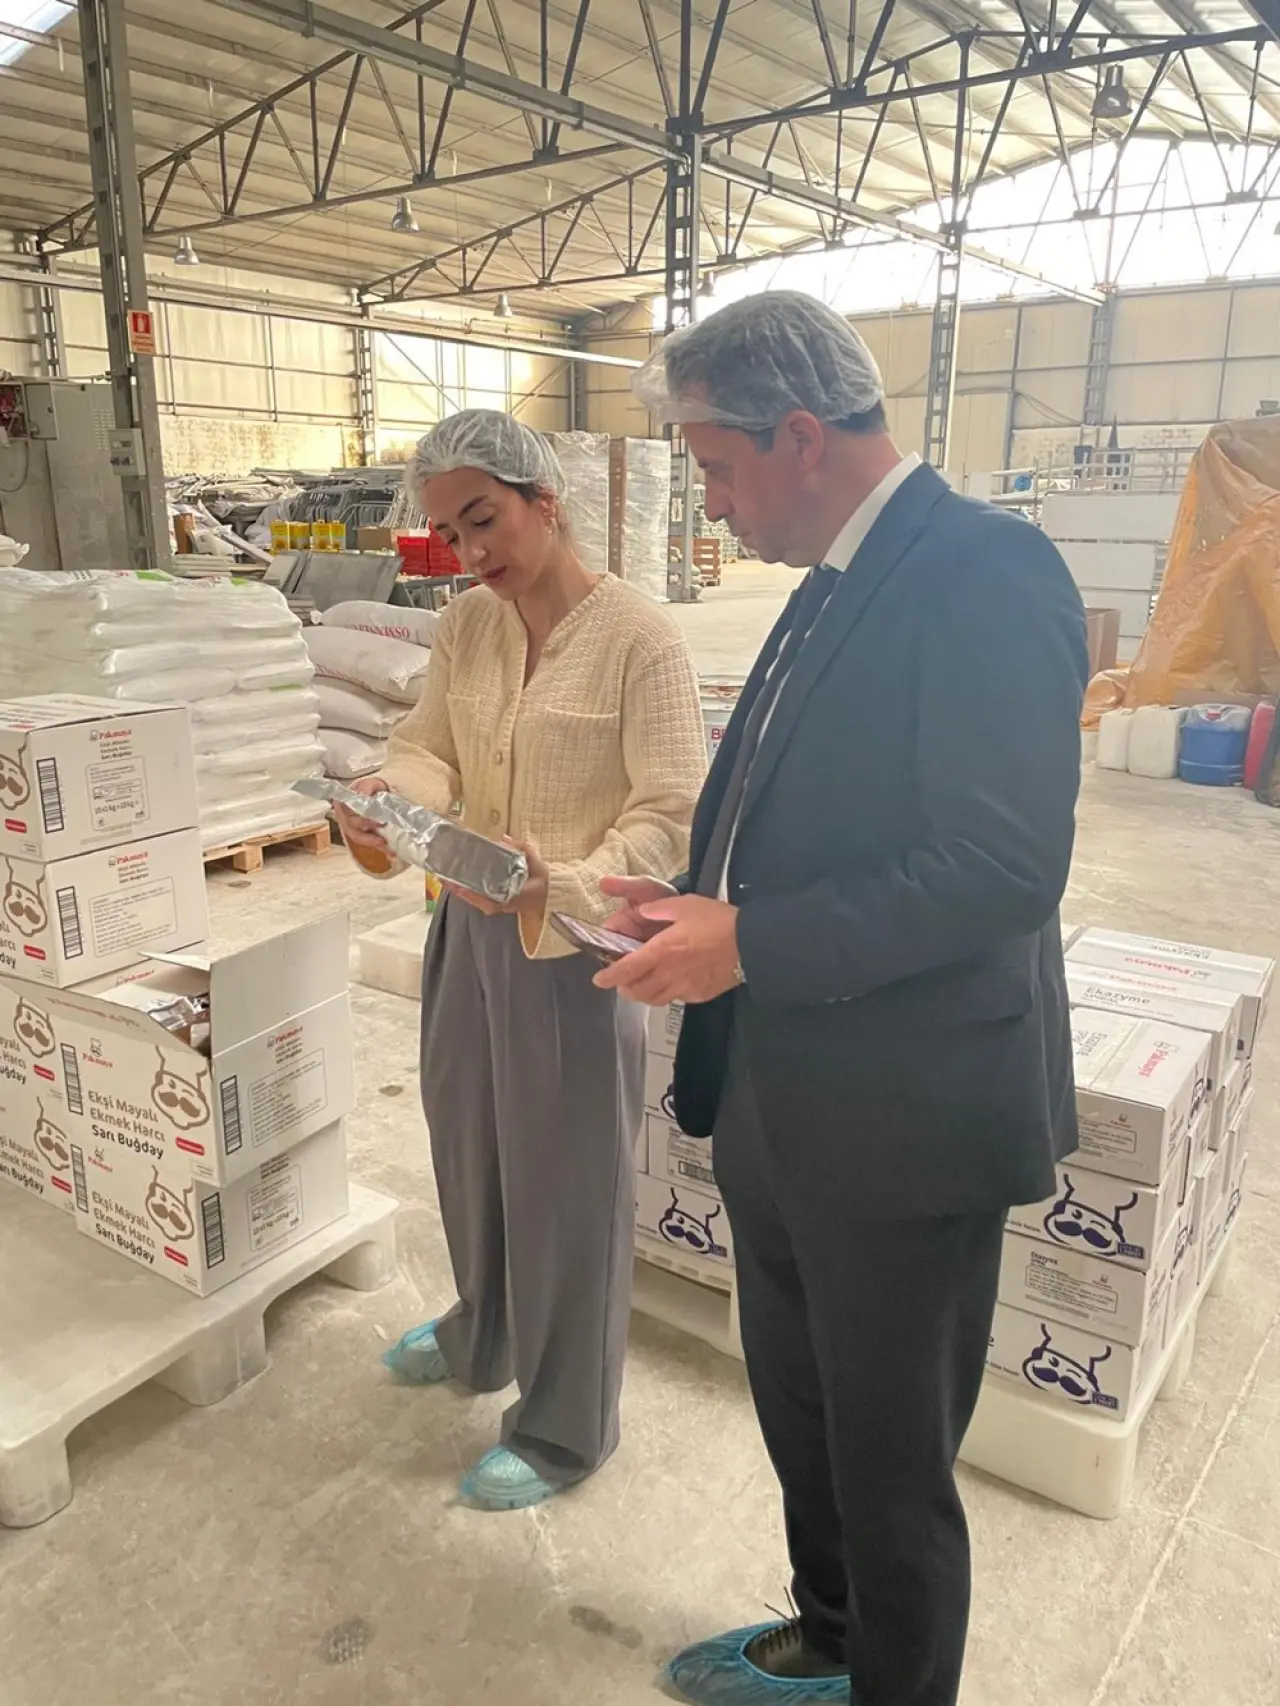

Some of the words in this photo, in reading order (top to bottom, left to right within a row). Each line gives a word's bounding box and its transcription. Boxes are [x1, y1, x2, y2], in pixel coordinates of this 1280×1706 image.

[88, 1090, 114, 1110] Ekşi
[116, 1098, 158, 1123] Mayalı
[90, 1107, 131, 1131] Ekmek
[133, 1120, 166, 1142] Harcı
[92, 1124, 115, 1142] Sarı
[118, 1132, 164, 1159] Buğday
[94, 1207, 127, 1234] Ekmek
[116, 1234, 154, 1264] Buğday
